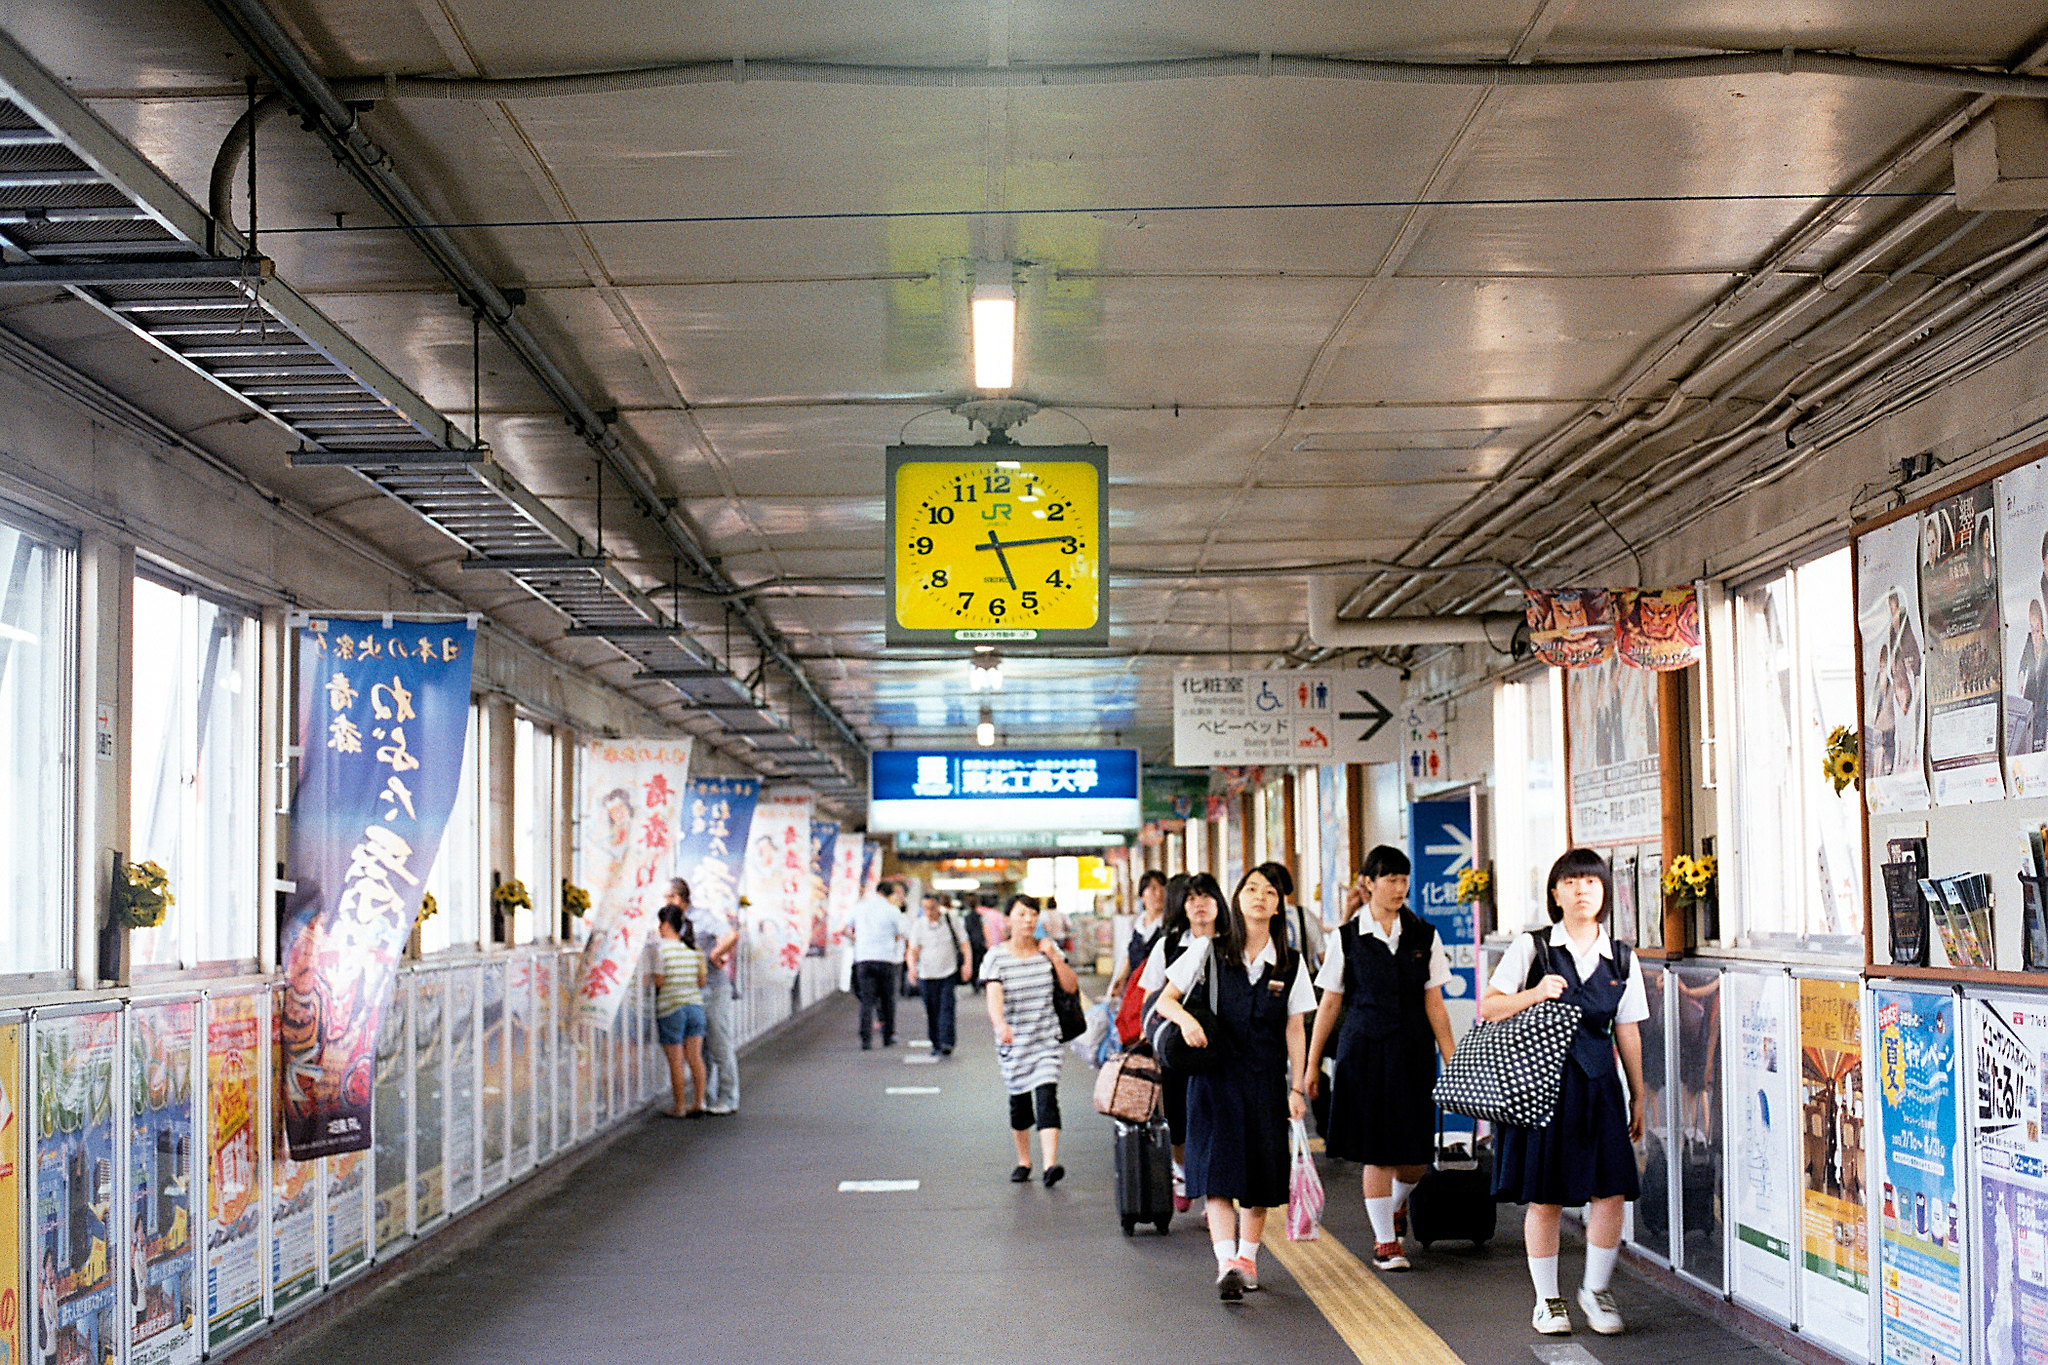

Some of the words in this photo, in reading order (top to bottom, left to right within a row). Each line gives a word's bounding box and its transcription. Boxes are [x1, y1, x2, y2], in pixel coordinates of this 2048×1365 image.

[984, 476, 1010, 493] 12
[1026, 484, 1033, 496] 1
[954, 485, 977, 502] 11
[929, 507, 954, 524] 10
[982, 504, 1012, 520] JR
[1048, 504, 1064, 521] 2
[917, 537, 933, 555] 9
[1061, 537, 1077, 554] 3
[931, 570, 948, 587] 8
[1046, 570, 1063, 587] 4
[959, 592, 974, 609] 7
[989, 599, 1005, 616] 6
[1022, 592, 1038, 608] 5
[1183, 677, 1243, 693] 化粧室
[1198, 720, 1287, 734] ベビーベッド
